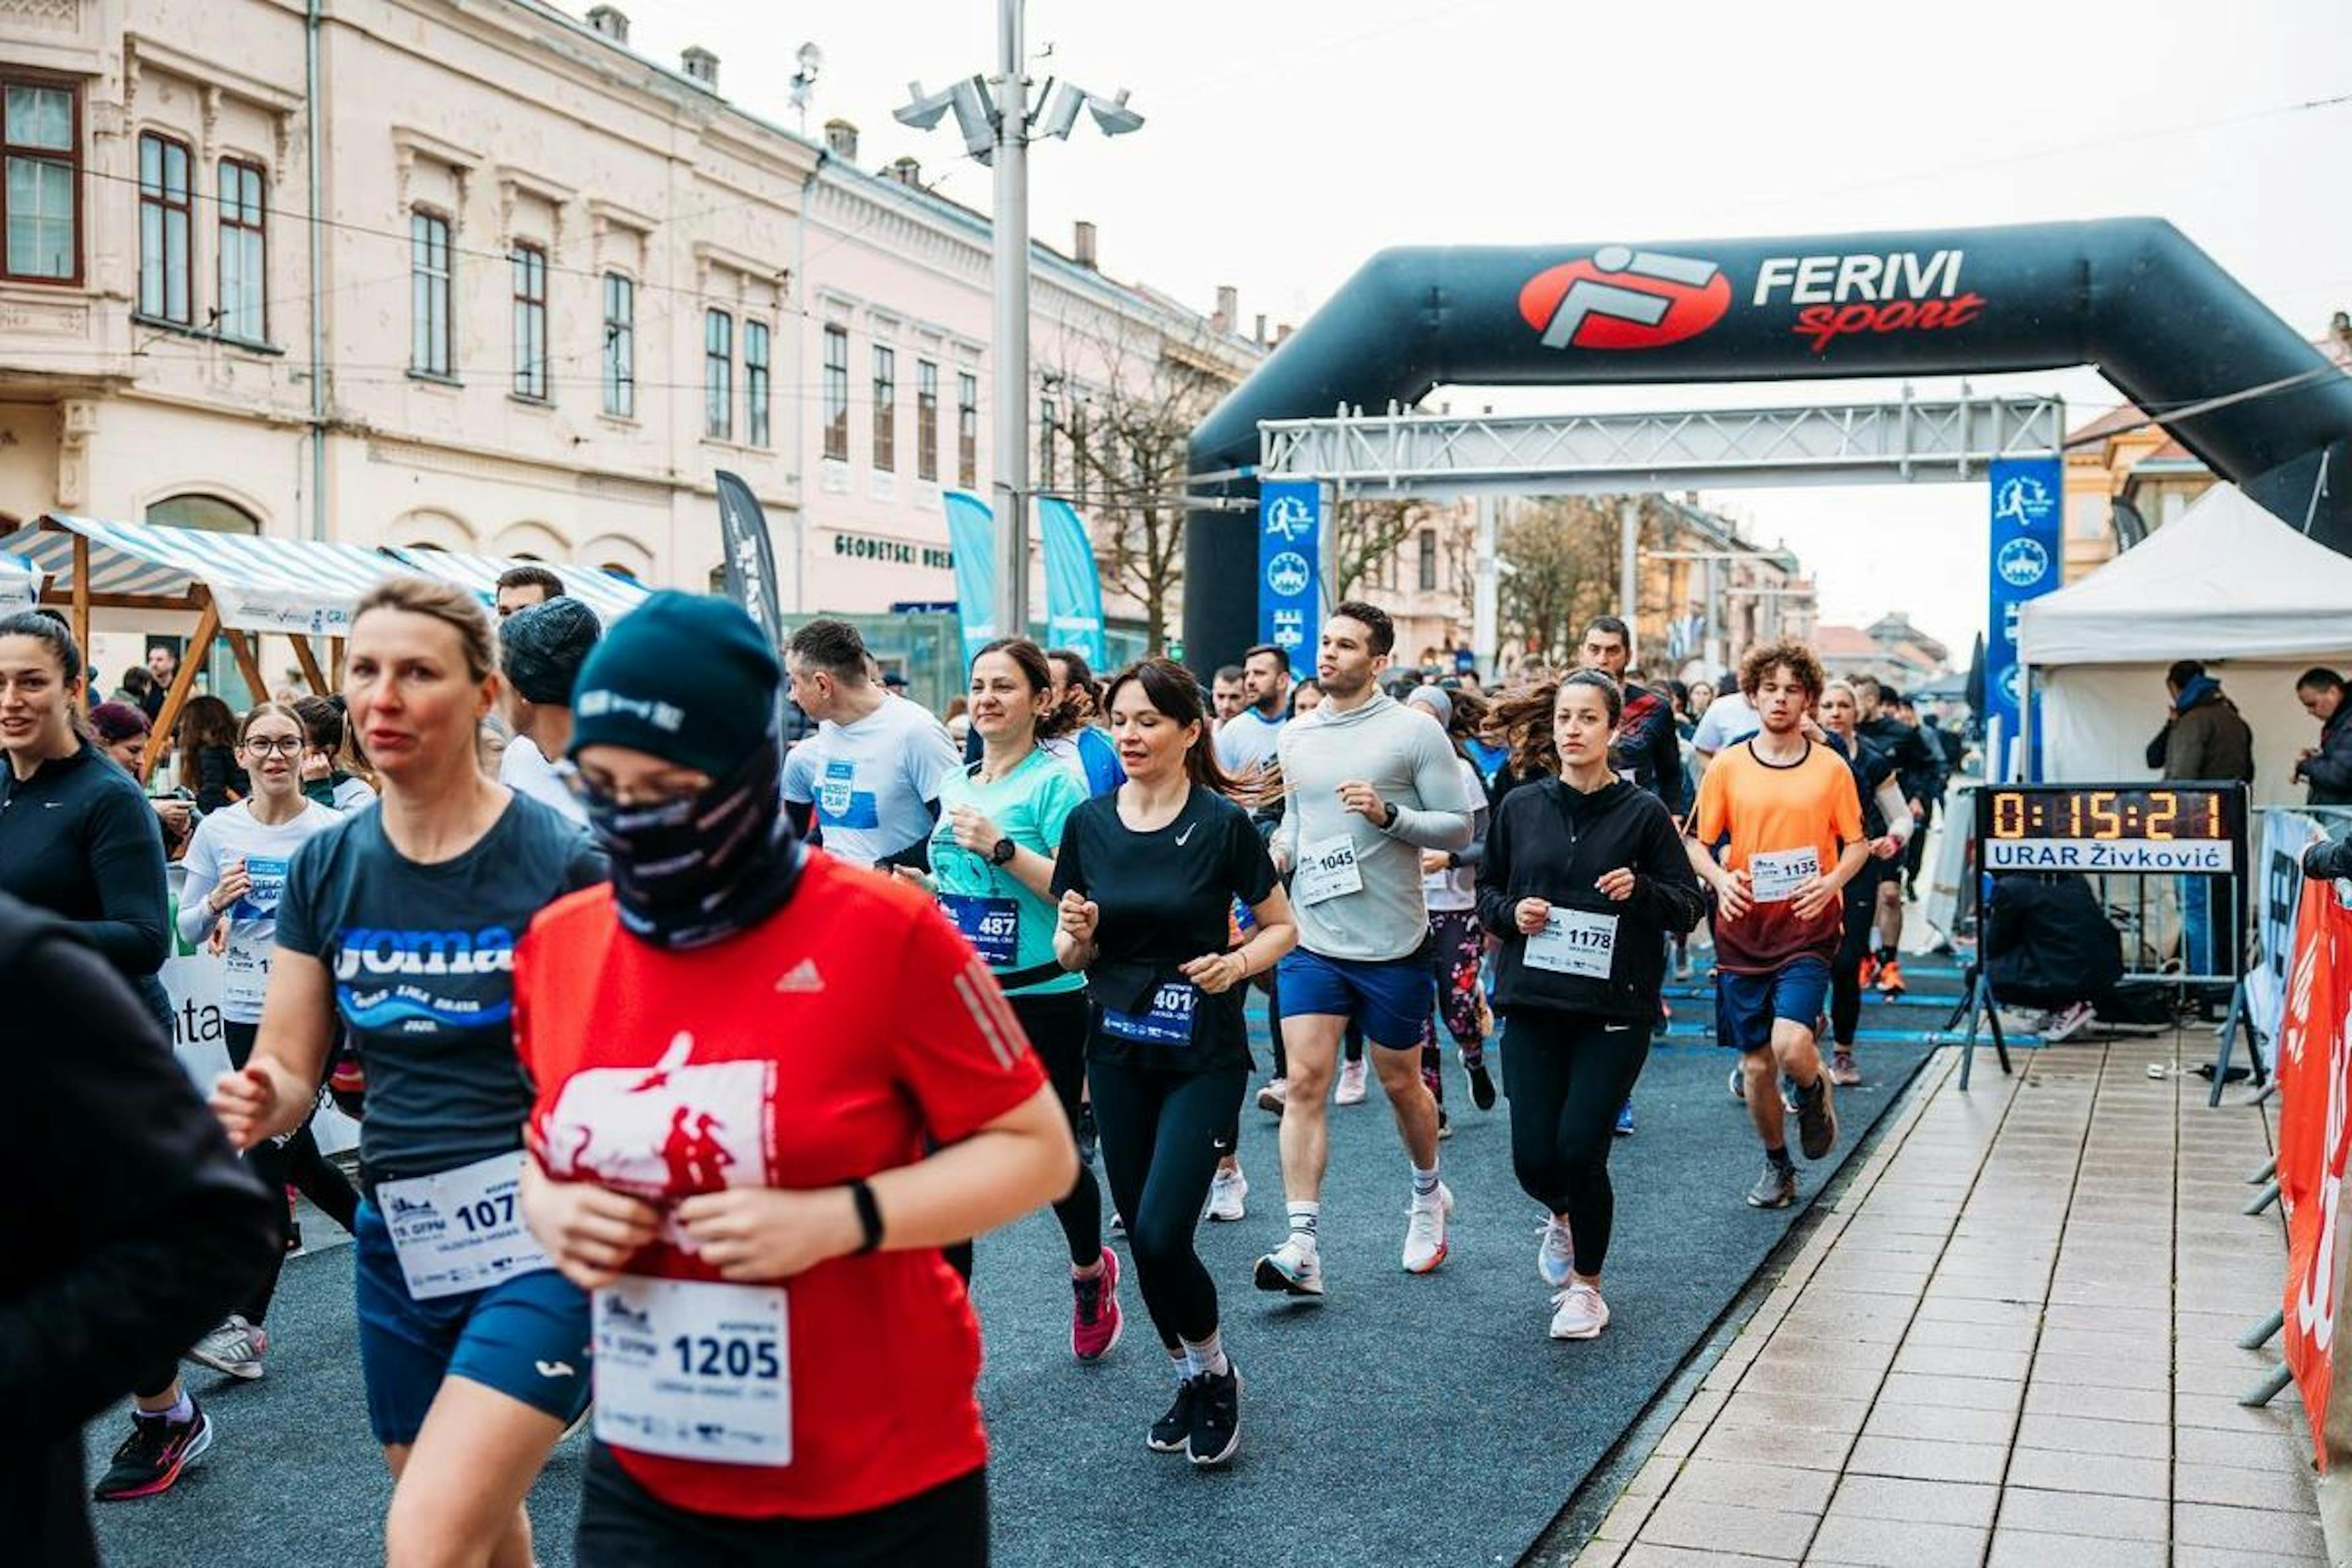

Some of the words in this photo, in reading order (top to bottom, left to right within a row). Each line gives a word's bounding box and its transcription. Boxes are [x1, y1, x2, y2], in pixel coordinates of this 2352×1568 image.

[1753, 250, 1964, 305] FERIVI
[1791, 292, 1988, 355] sport
[834, 534, 917, 565] GEODETSKI
[1994, 791, 2220, 840] 0:15:21
[1319, 850, 1354, 870] 1045
[1784, 860, 1817, 876] 1135
[1995, 846, 2080, 865] URAR
[2090, 843, 2221, 867] Živković
[978, 916, 1016, 936] 487
[1569, 929, 1611, 949] 1178
[1153, 989, 1192, 1011] 401
[456, 1193, 516, 1232] 107
[673, 1333, 780, 1379] 1205
